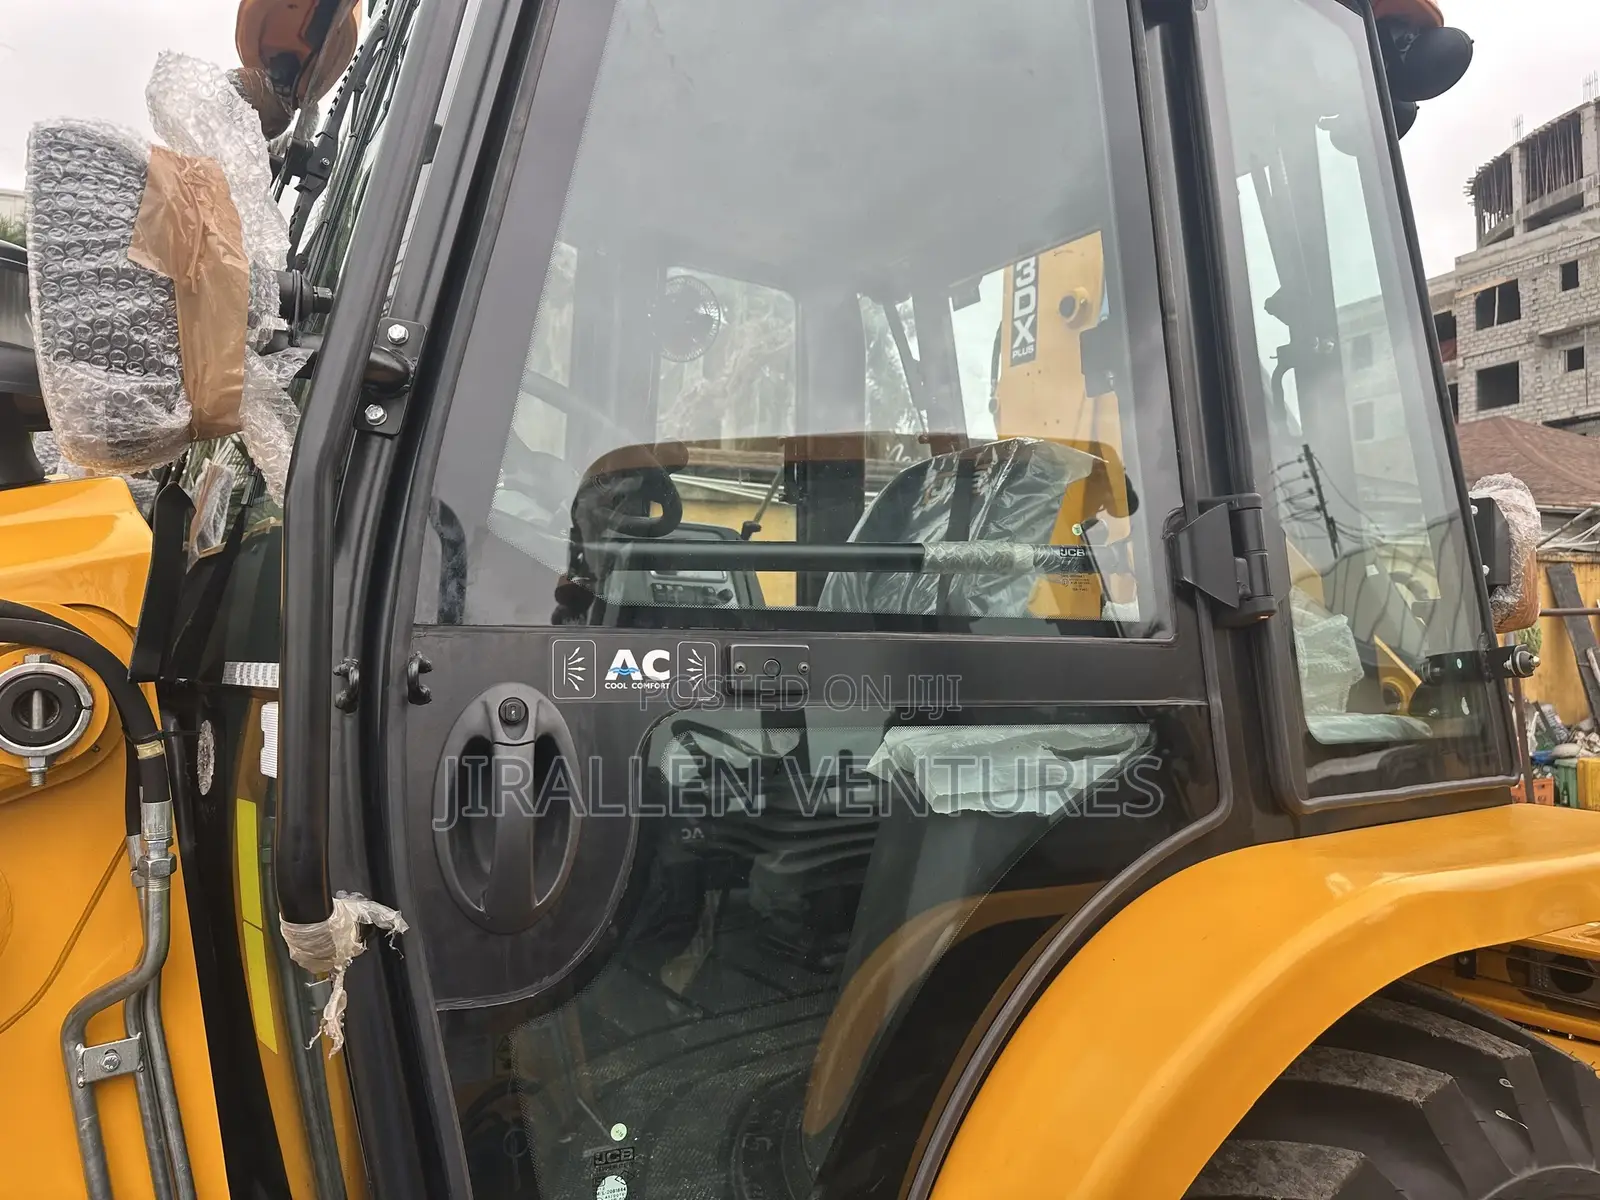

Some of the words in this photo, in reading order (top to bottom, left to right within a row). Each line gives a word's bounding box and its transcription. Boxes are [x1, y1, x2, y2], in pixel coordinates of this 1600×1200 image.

[1012, 256, 1036, 350] 3DX
[1012, 344, 1035, 360] PLUS
[1060, 547, 1086, 558] JCB
[604, 649, 671, 681] AC
[604, 682, 629, 690] COOL
[631, 682, 671, 690] COMFORT
[594, 1148, 634, 1166] JCB
